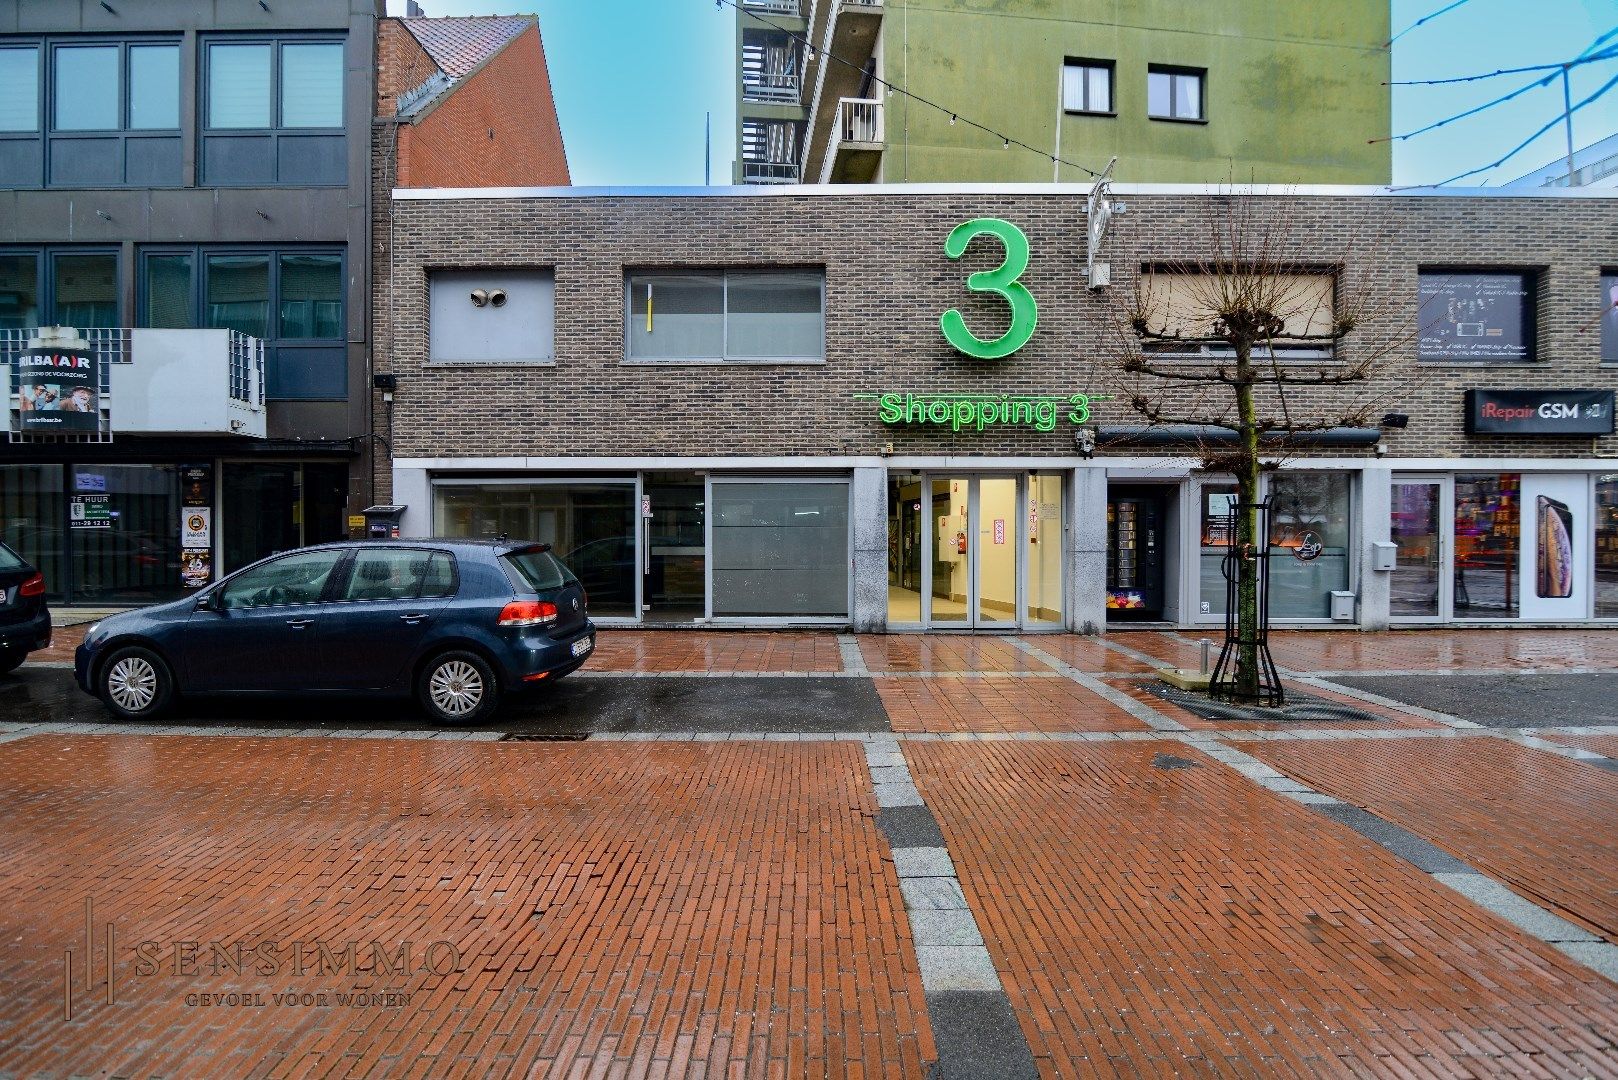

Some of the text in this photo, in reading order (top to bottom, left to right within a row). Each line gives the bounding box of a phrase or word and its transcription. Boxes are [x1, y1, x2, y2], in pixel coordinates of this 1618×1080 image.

[940, 217, 1038, 359] 3
[879, 393, 1091, 432] Shopping 3
[1481, 402, 1579, 421] iRepair GSM
